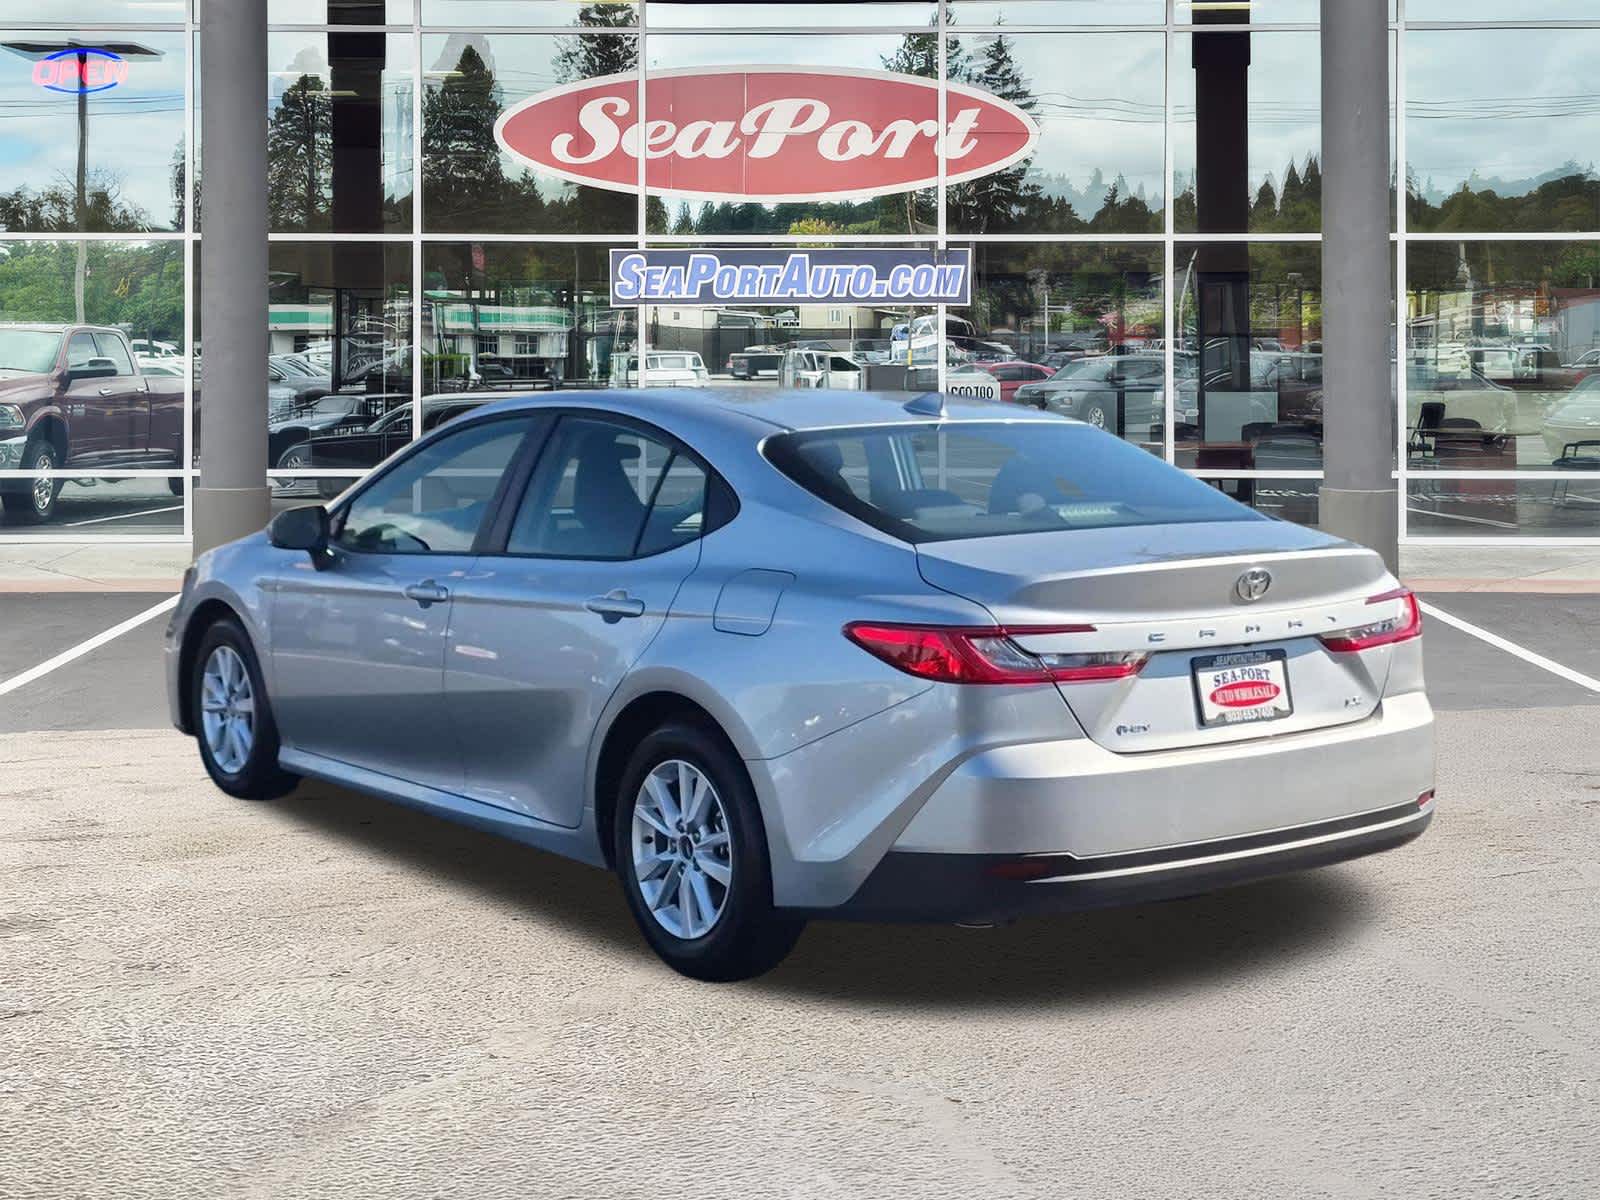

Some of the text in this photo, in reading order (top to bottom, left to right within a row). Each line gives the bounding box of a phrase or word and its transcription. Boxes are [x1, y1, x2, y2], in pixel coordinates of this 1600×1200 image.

[32, 59, 128, 85] OPEN
[550, 95, 982, 164] SeaPort
[1213, 668, 1271, 688] SEA-PORT
